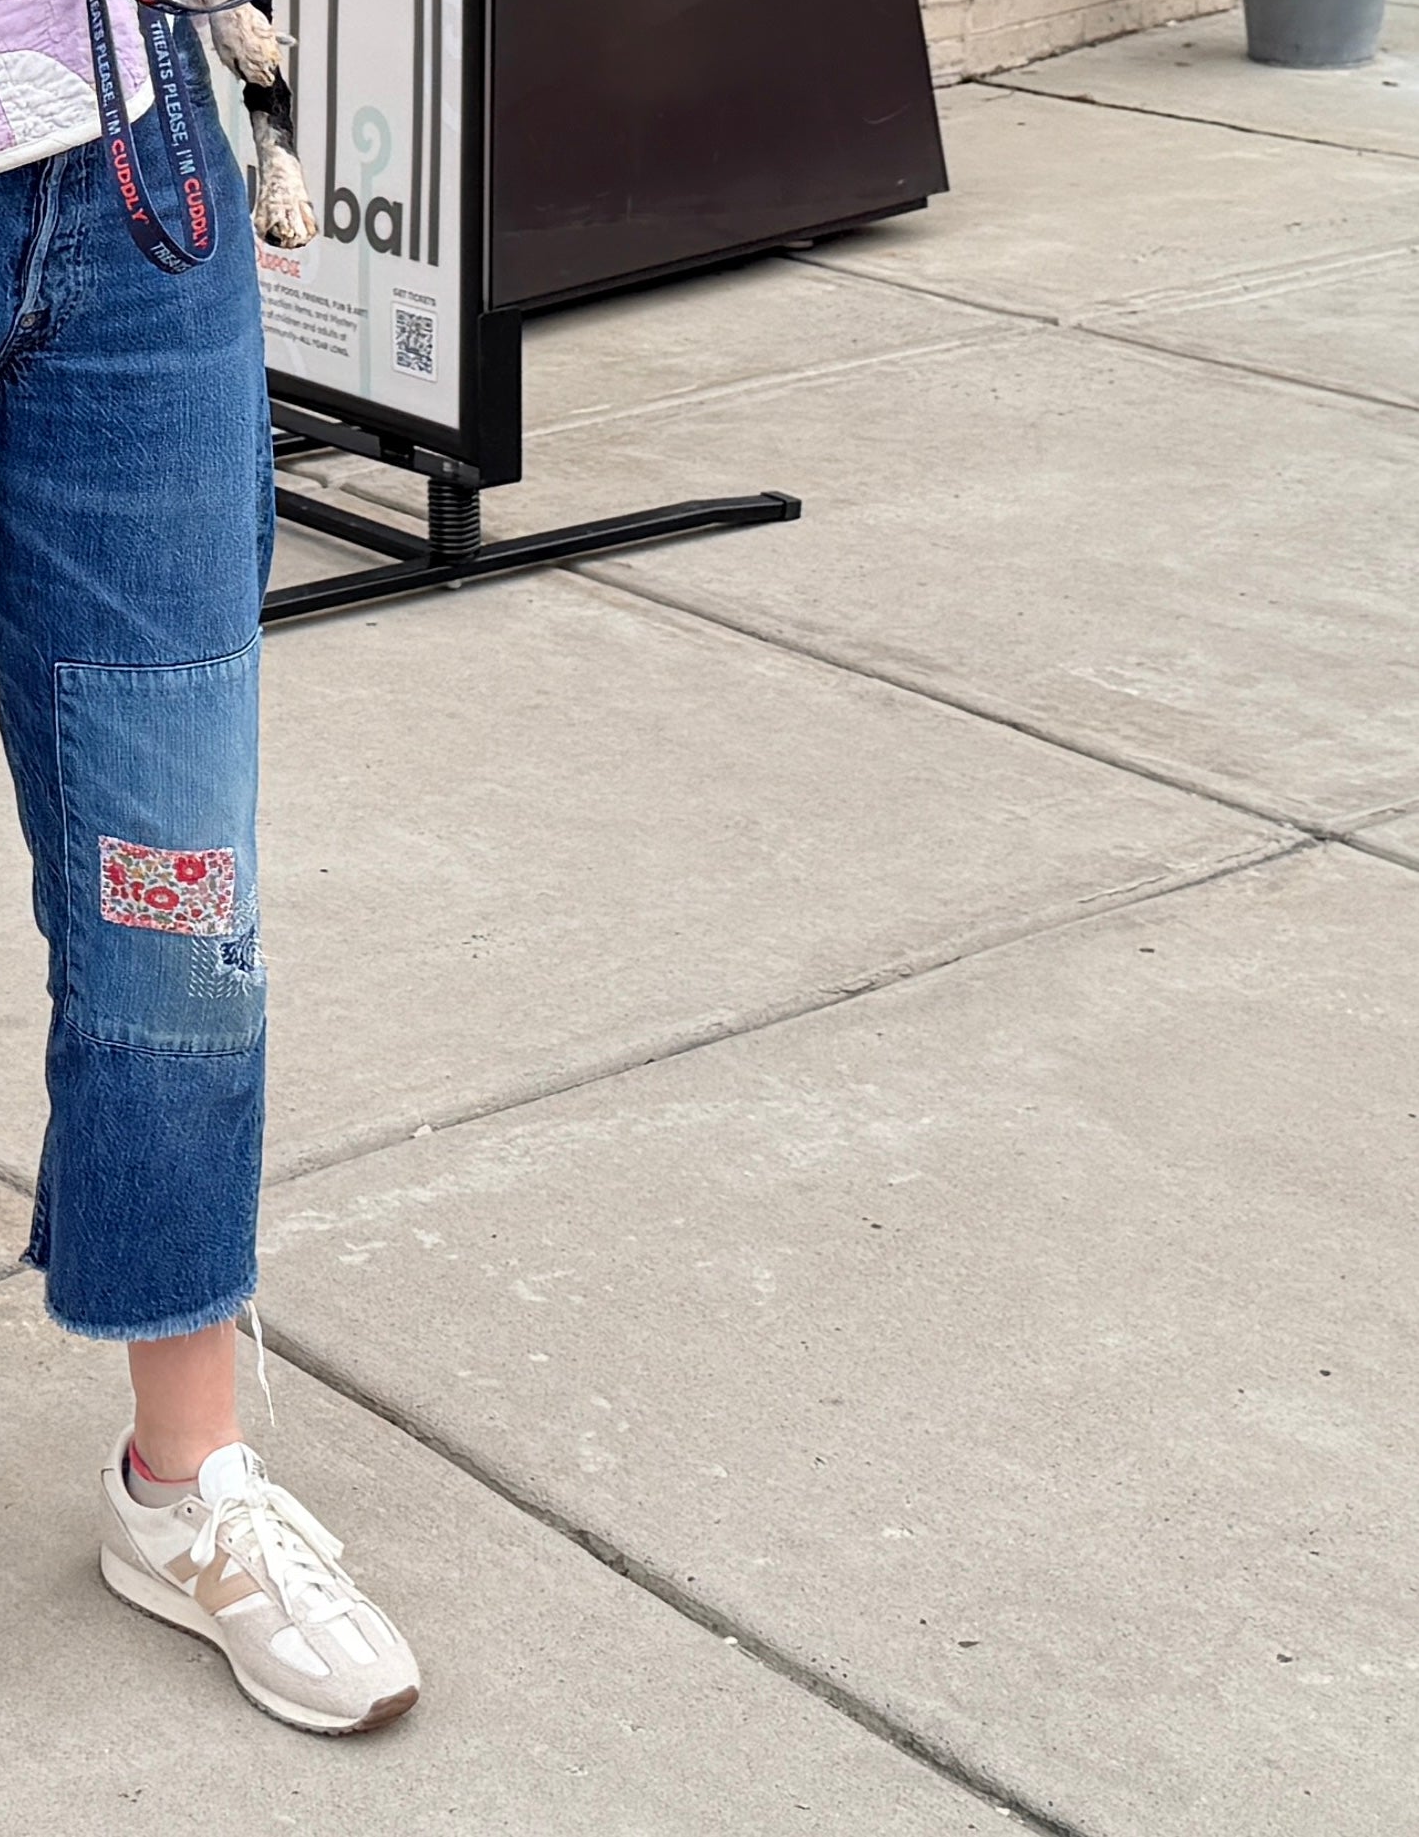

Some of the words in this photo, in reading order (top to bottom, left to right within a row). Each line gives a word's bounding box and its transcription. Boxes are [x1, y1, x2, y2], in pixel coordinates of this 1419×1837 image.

[105, 109, 122, 136] I'M
[112, 138, 150, 225] CUDDLY
[176, 149, 196, 175] I'M
[184, 177, 209, 250] CUDDLY
